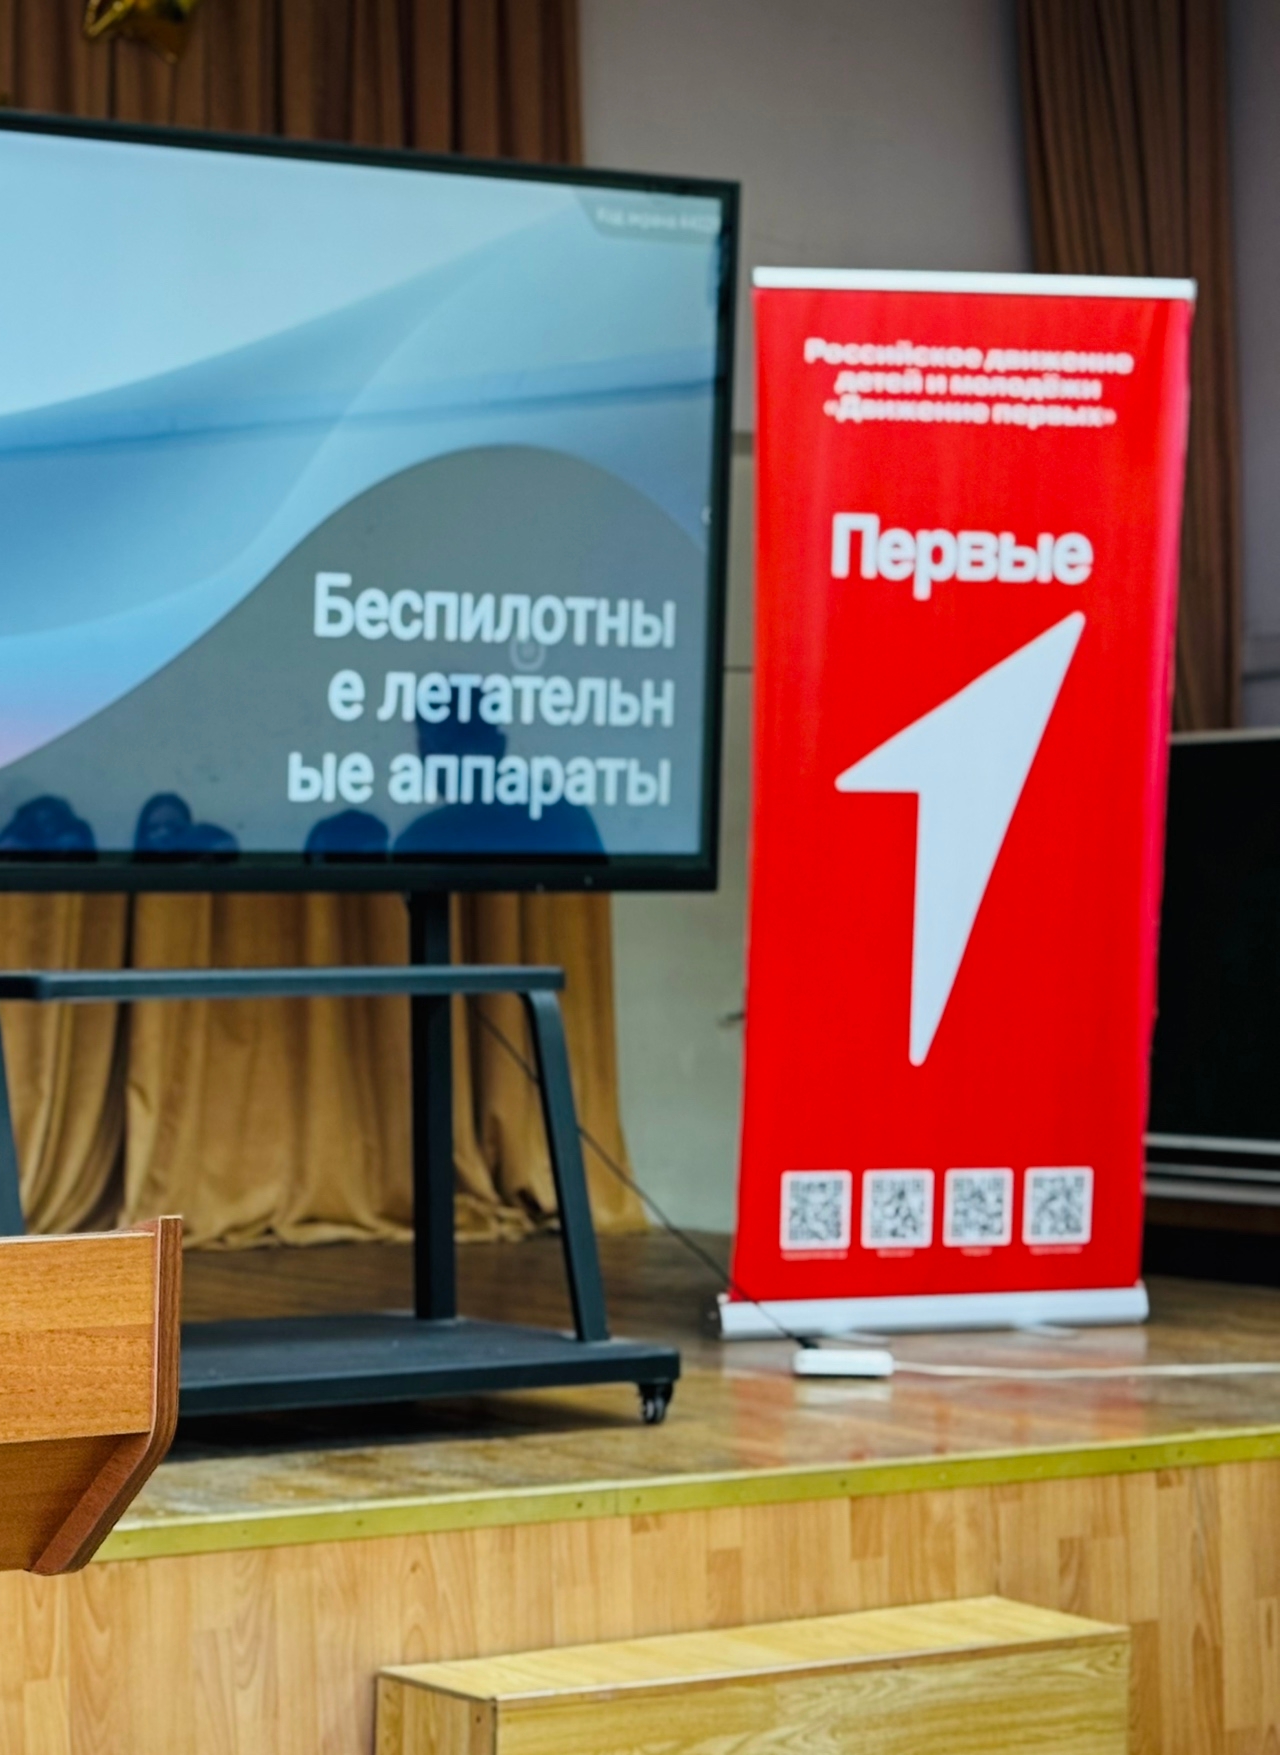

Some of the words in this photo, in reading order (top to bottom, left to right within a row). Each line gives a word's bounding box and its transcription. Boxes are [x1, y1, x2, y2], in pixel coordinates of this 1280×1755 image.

[831, 511, 1094, 601] Первые
[314, 572, 675, 648] Беспилотны
[328, 669, 365, 721] е
[376, 671, 674, 727] летательн
[288, 751, 374, 803] ые
[388, 752, 670, 820] аппараты
